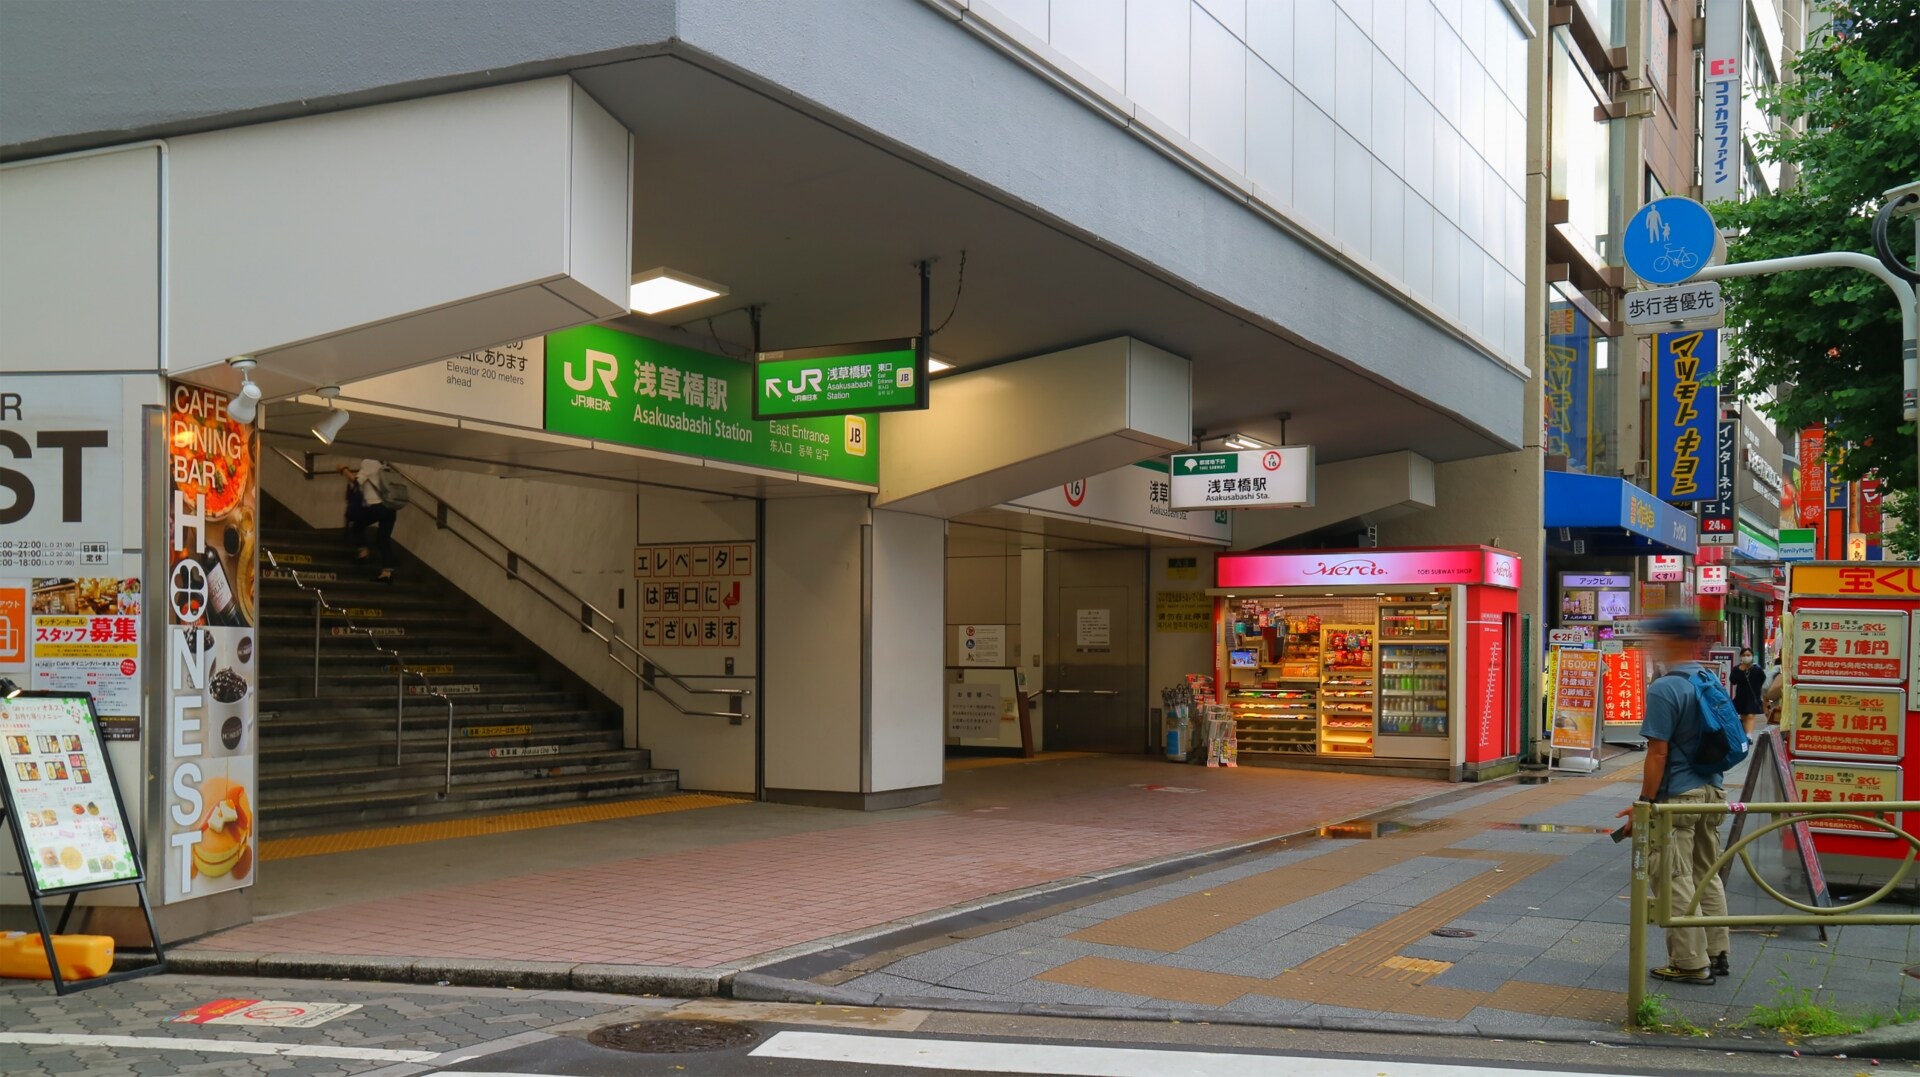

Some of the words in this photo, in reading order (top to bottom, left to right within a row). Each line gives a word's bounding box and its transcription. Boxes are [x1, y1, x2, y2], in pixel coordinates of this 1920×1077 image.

[1715, 82, 1729, 184] ココカラファイン
[1629, 290, 1714, 318] 歩行者優先
[446, 361, 480, 376] Elevator
[482, 369, 496, 380] 200
[498, 373, 524, 385] meters
[564, 349, 618, 397] JR
[827, 364, 872, 381] 浅草橋駅
[877, 363, 892, 372] 東口
[446, 375, 472, 387] ahead
[787, 369, 822, 394] JR
[827, 379, 873, 391] Asakusabashi
[900, 373, 909, 382] JB
[634, 360, 728, 412] 浅草橋駅
[174, 385, 228, 422] CAFE
[571, 394, 611, 411] JR東日本
[792, 393, 818, 403] JR東日本
[827, 392, 850, 400] Station
[1669, 332, 1704, 496] マツモトキヨシ
[633, 404, 711, 437] Asakusabashi
[714, 416, 752, 443] Station
[174, 421, 241, 459] DINING
[769, 420, 790, 437] East
[792, 425, 829, 444] Entrance
[850, 429, 861, 443] JB
[770, 439, 792, 455] 东入口
[816, 449, 829, 461] 입구
[174, 456, 216, 487] BAR
[1719, 424, 1732, 515] インターネット
[1069, 480, 1080, 497] 16
[1208, 477, 1267, 493] 浅草橋駅
[1206, 493, 1255, 502] Asakusabashi
[1256, 492, 1270, 500] Sta.
[1215, 510, 1226, 521] A3
[1708, 520, 1726, 530] 24h
[1711, 535, 1723, 543] 4F
[83, 545, 105, 553] 日曜日
[86, 554, 103, 562] 定休
[638, 550, 748, 570] エレベーター
[1580, 577, 1613, 585] アックビル
[1655, 572, 1676, 580] くすり
[646, 586, 717, 605] は西口に
[36, 628, 88, 642] スタッフ
[90, 617, 137, 642] 募集
[1863, 623, 1887, 631] 宝くじ
[1562, 633, 1573, 641] 2F
[1803, 637, 1839, 655] 2等
[1844, 639, 1889, 656] 1億円
[1561, 660, 1597, 669] 1500円
[1561, 678, 1594, 686] 骨盤矯正
[1618, 650, 1633, 719] 木目込人形材料
[1560, 699, 1591, 707] 五十肩
[1860, 698, 1884, 707] 宝くじ
[1801, 712, 1836, 730] 2等
[1842, 714, 1887, 731] 1億円
[1857, 776, 1880, 785] 宝くじ
